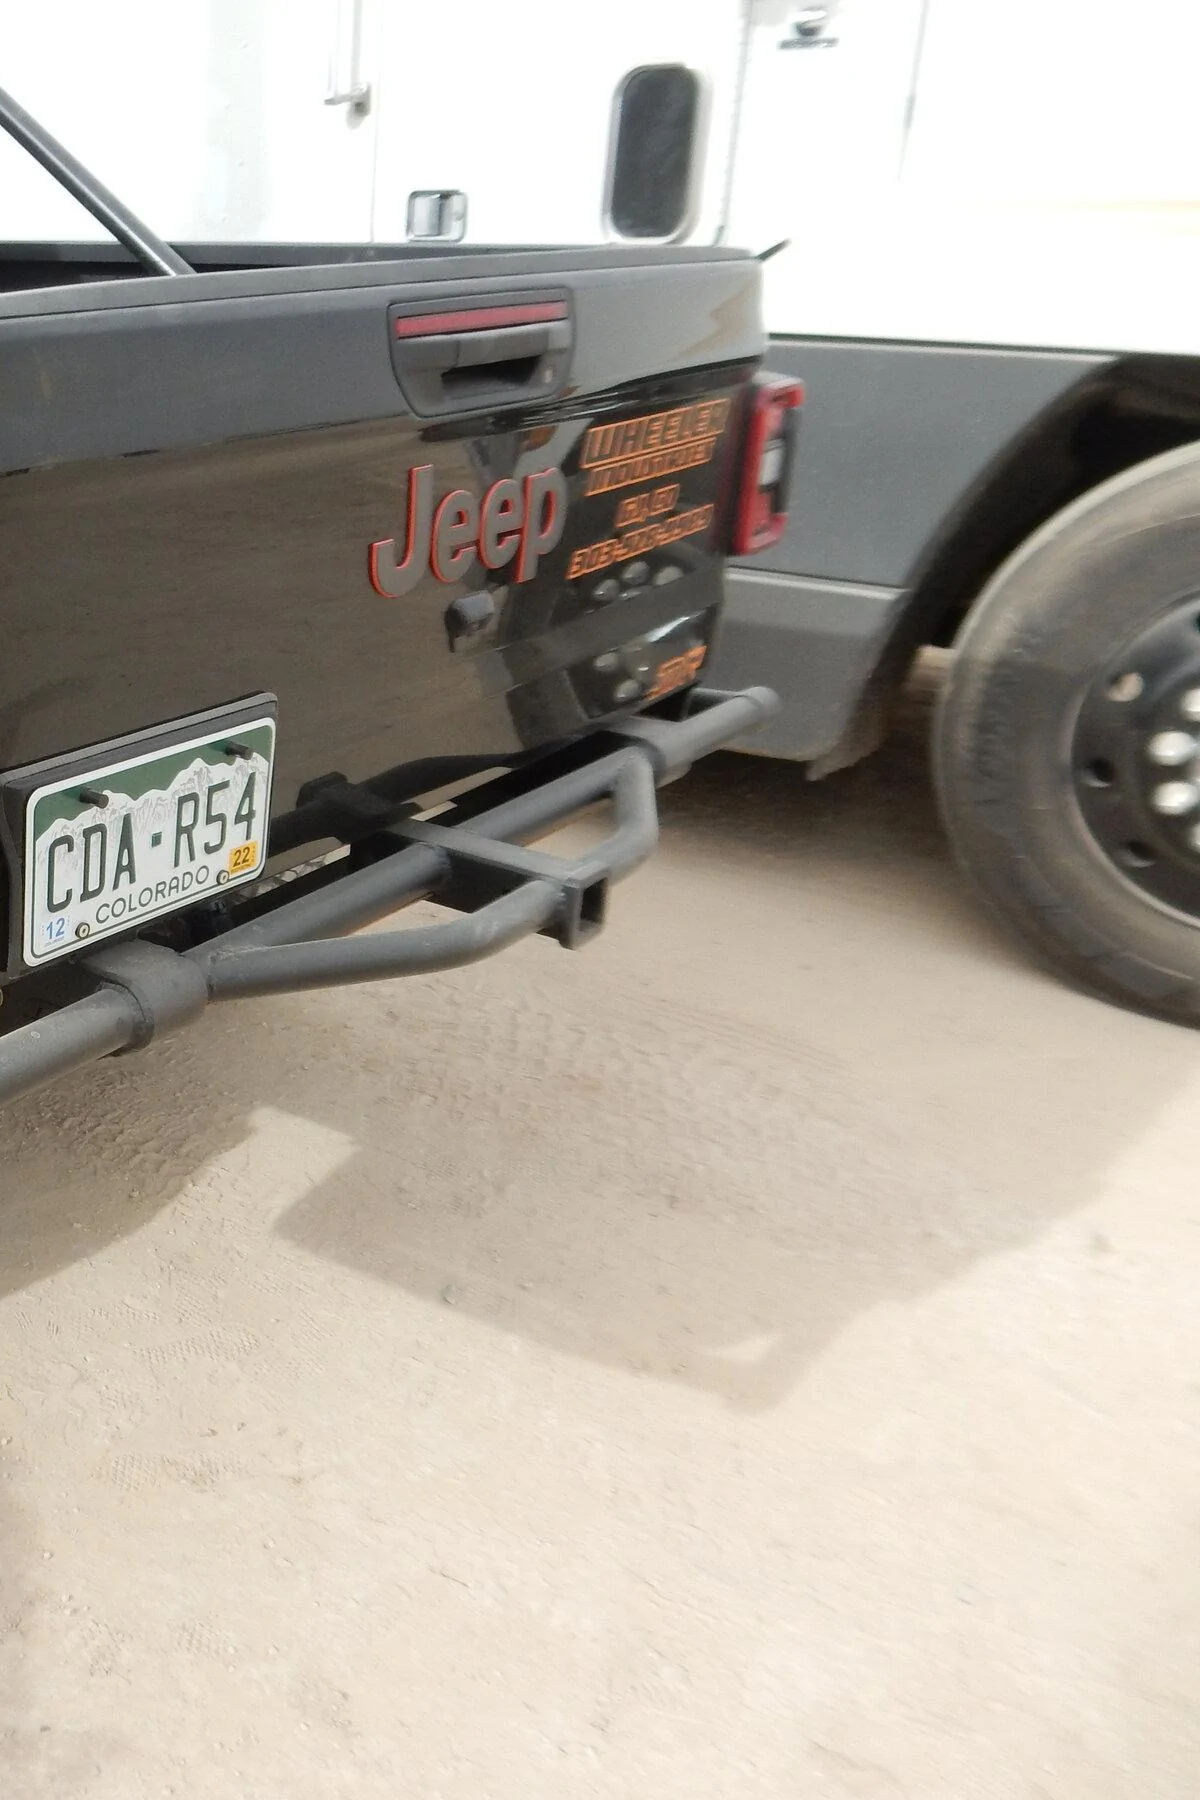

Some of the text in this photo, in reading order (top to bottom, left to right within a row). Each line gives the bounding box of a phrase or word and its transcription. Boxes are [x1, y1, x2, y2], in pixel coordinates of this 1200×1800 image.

[369, 463, 568, 598] Jeep
[232, 846, 250, 867] 22
[95, 864, 210, 924] COLORADO
[46, 917, 65, 939] 12
